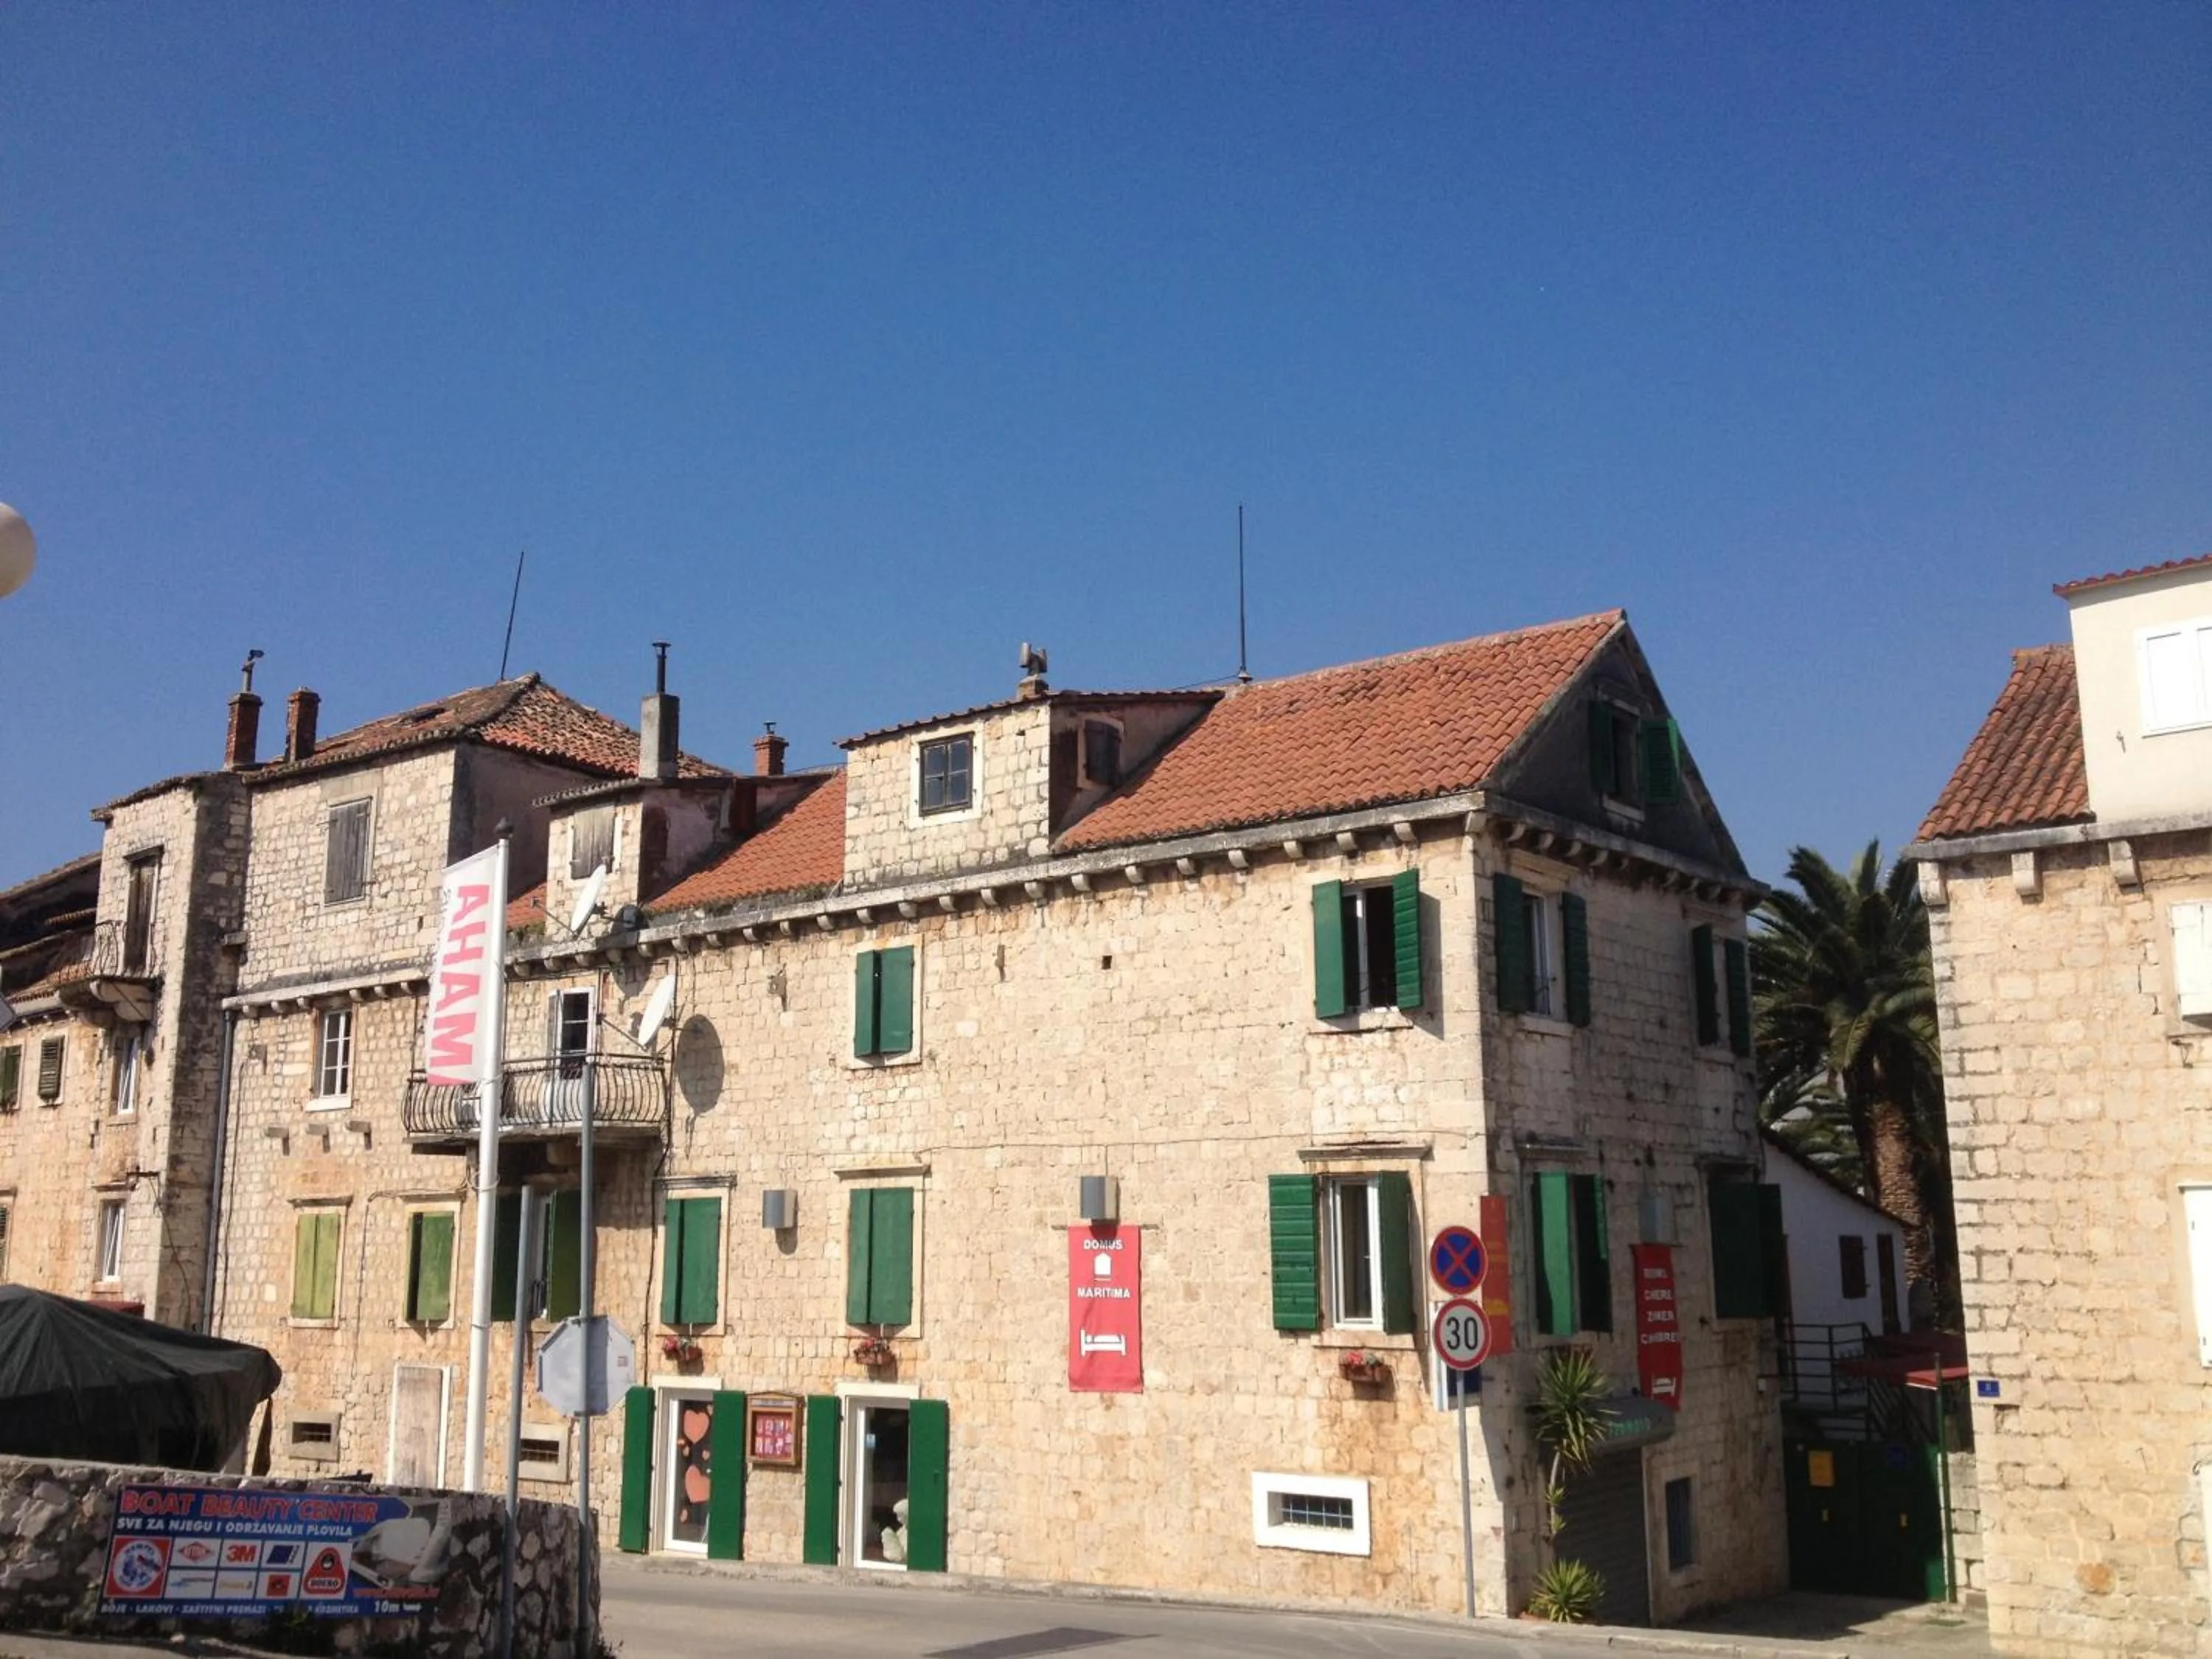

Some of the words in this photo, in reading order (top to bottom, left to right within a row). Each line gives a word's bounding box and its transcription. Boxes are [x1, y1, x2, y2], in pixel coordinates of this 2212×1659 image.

[1083, 1239, 1123, 1250] DOMUS
[1077, 1287, 1131, 1298] MARITIMA
[1446, 1316, 1479, 1351] 30
[120, 1490, 195, 1515] BOAT
[200, 1493, 292, 1521] BEAUTY
[298, 1498, 378, 1523] CENTER
[116, 1517, 143, 1530] SVE
[145, 1517, 165, 1531] ZA
[168, 1519, 213, 1533] NJEGU
[306, 1524, 353, 1537] PLOVILA
[226, 1545, 257, 1563] 3M
